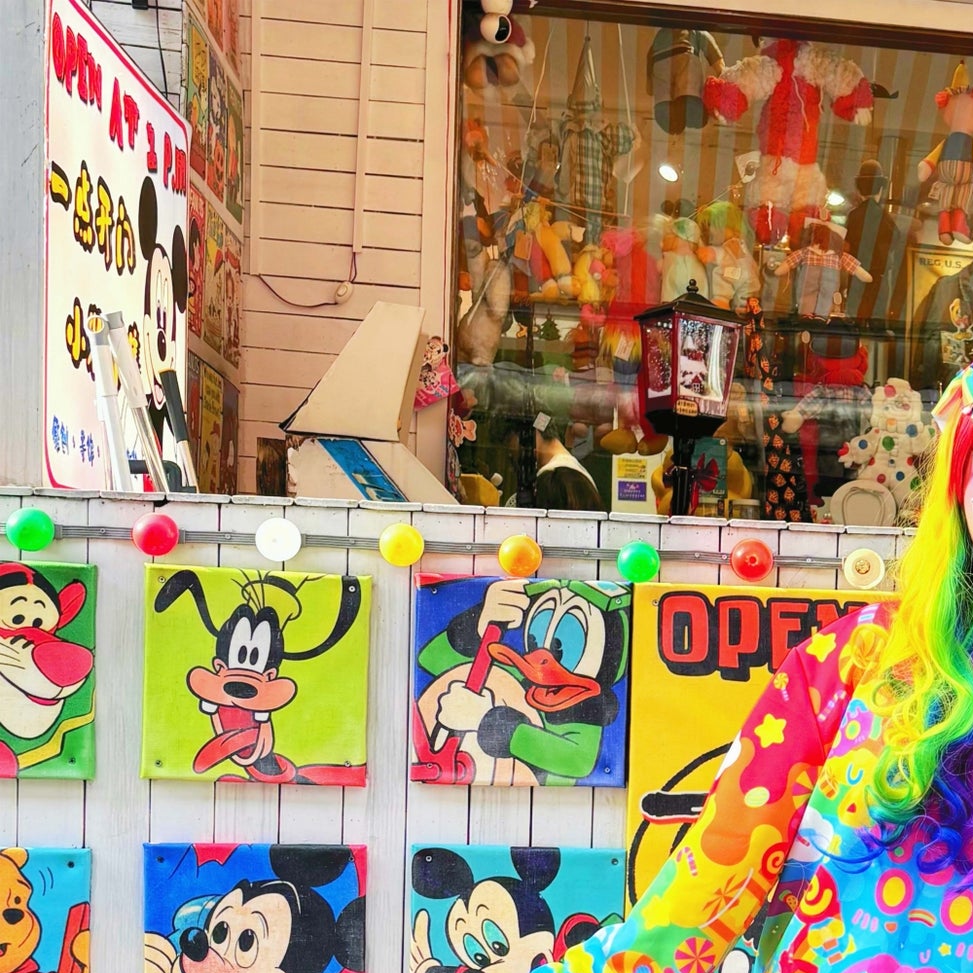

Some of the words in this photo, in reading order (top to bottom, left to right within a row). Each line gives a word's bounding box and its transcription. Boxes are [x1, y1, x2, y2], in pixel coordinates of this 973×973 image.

[52, 12, 103, 112] OPEN
[109, 77, 140, 151] AT
[146, 121, 157, 173] 1
[50, 160, 136, 276] 一点开门
